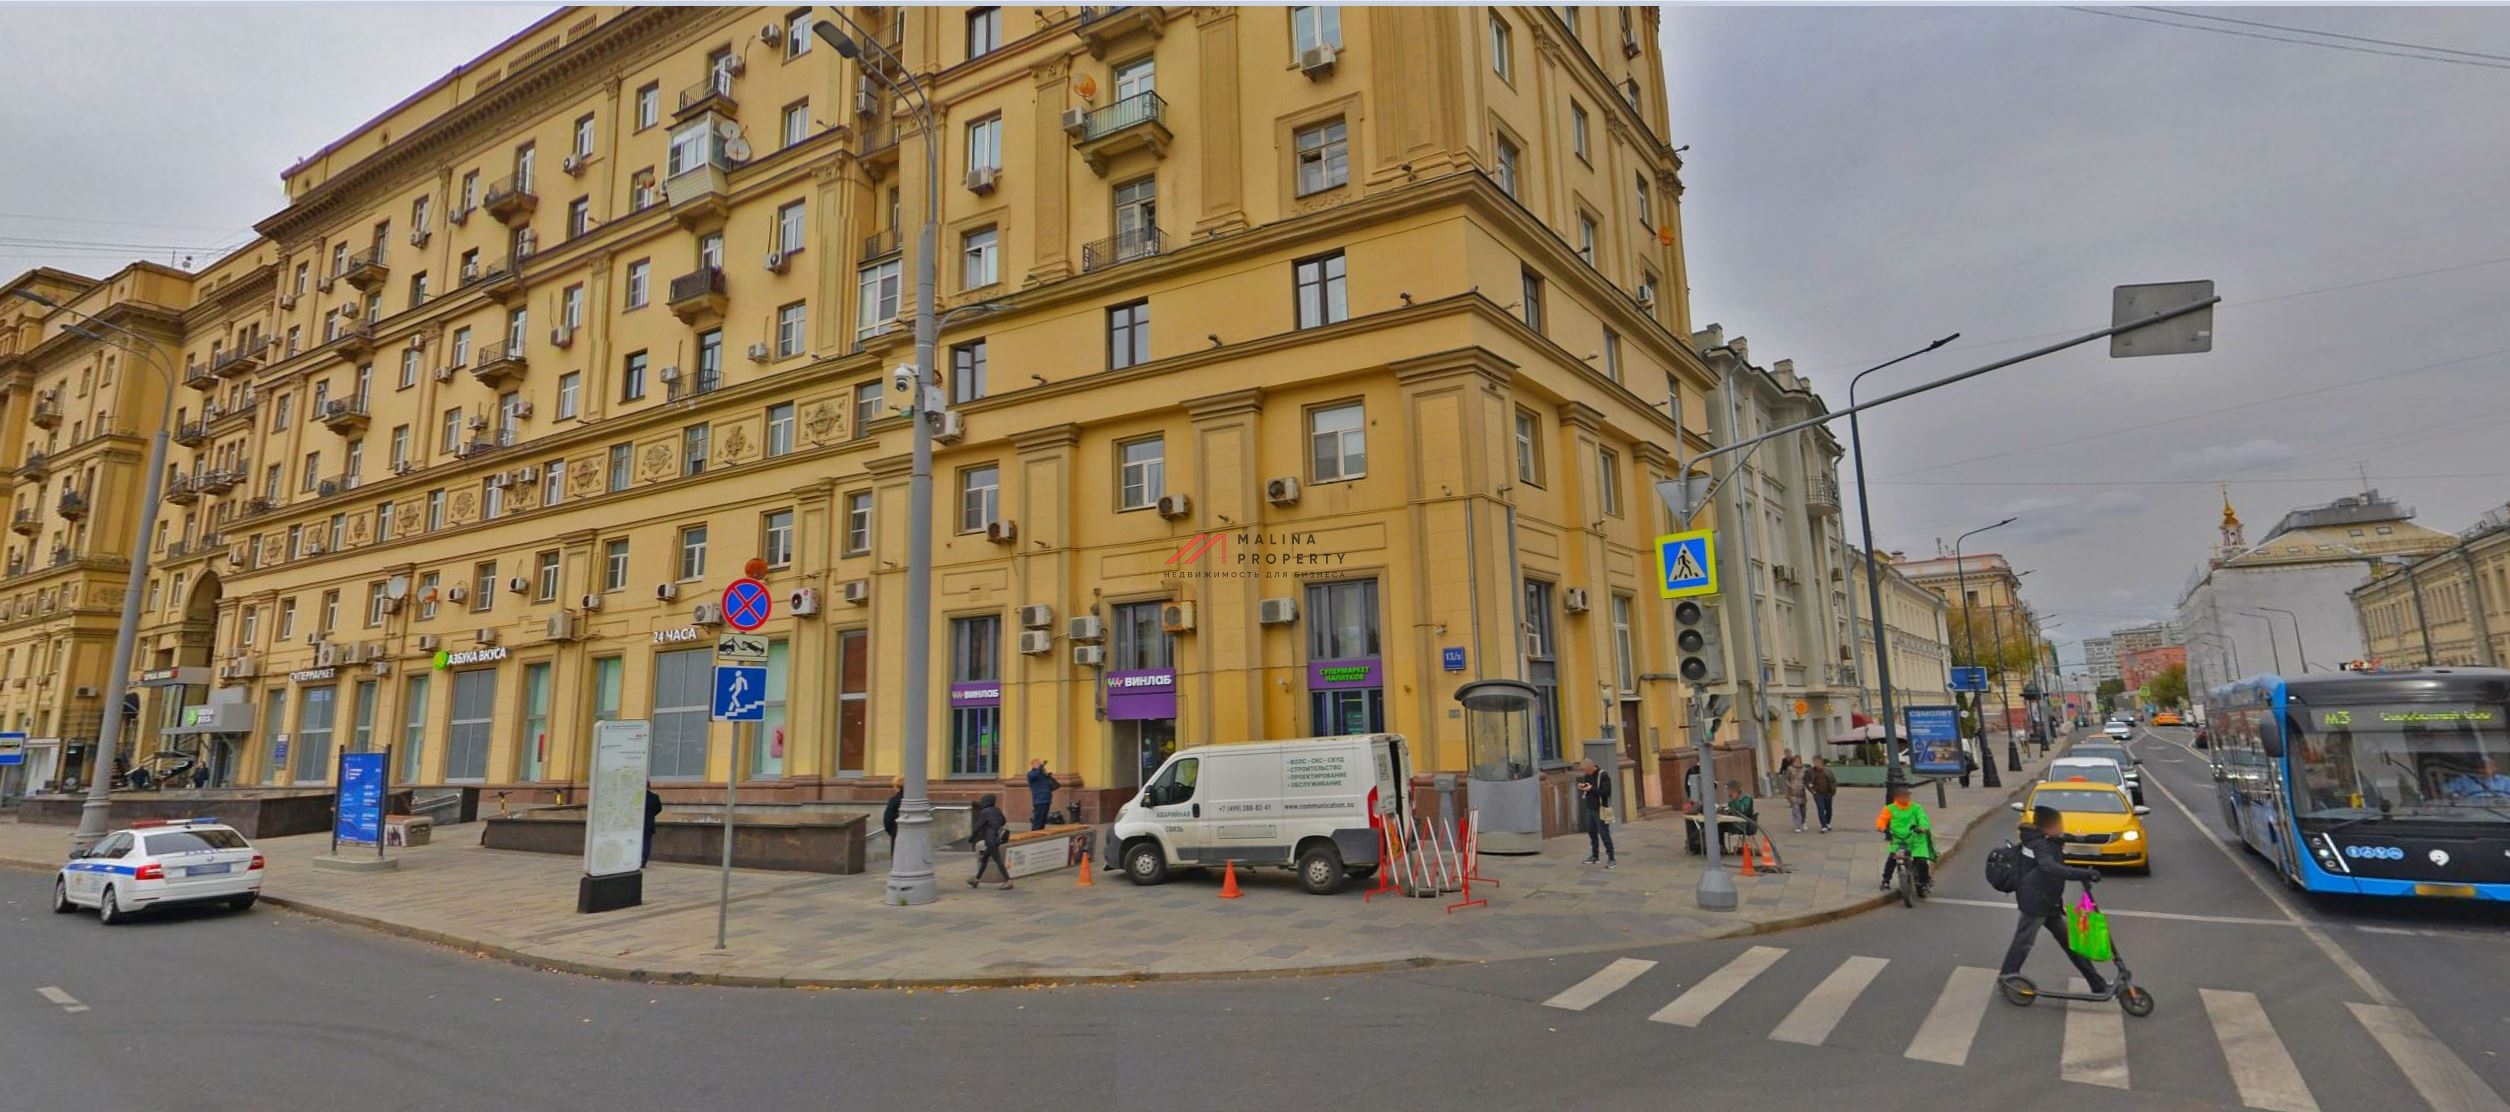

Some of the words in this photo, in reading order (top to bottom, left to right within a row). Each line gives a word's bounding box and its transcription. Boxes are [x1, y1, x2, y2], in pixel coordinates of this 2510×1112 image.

[653, 631, 664, 643] 24
[666, 628, 697, 641] ЧАСА
[447, 651, 478, 666] АЗБУКА
[479, 647, 507, 662] ВКУСА
